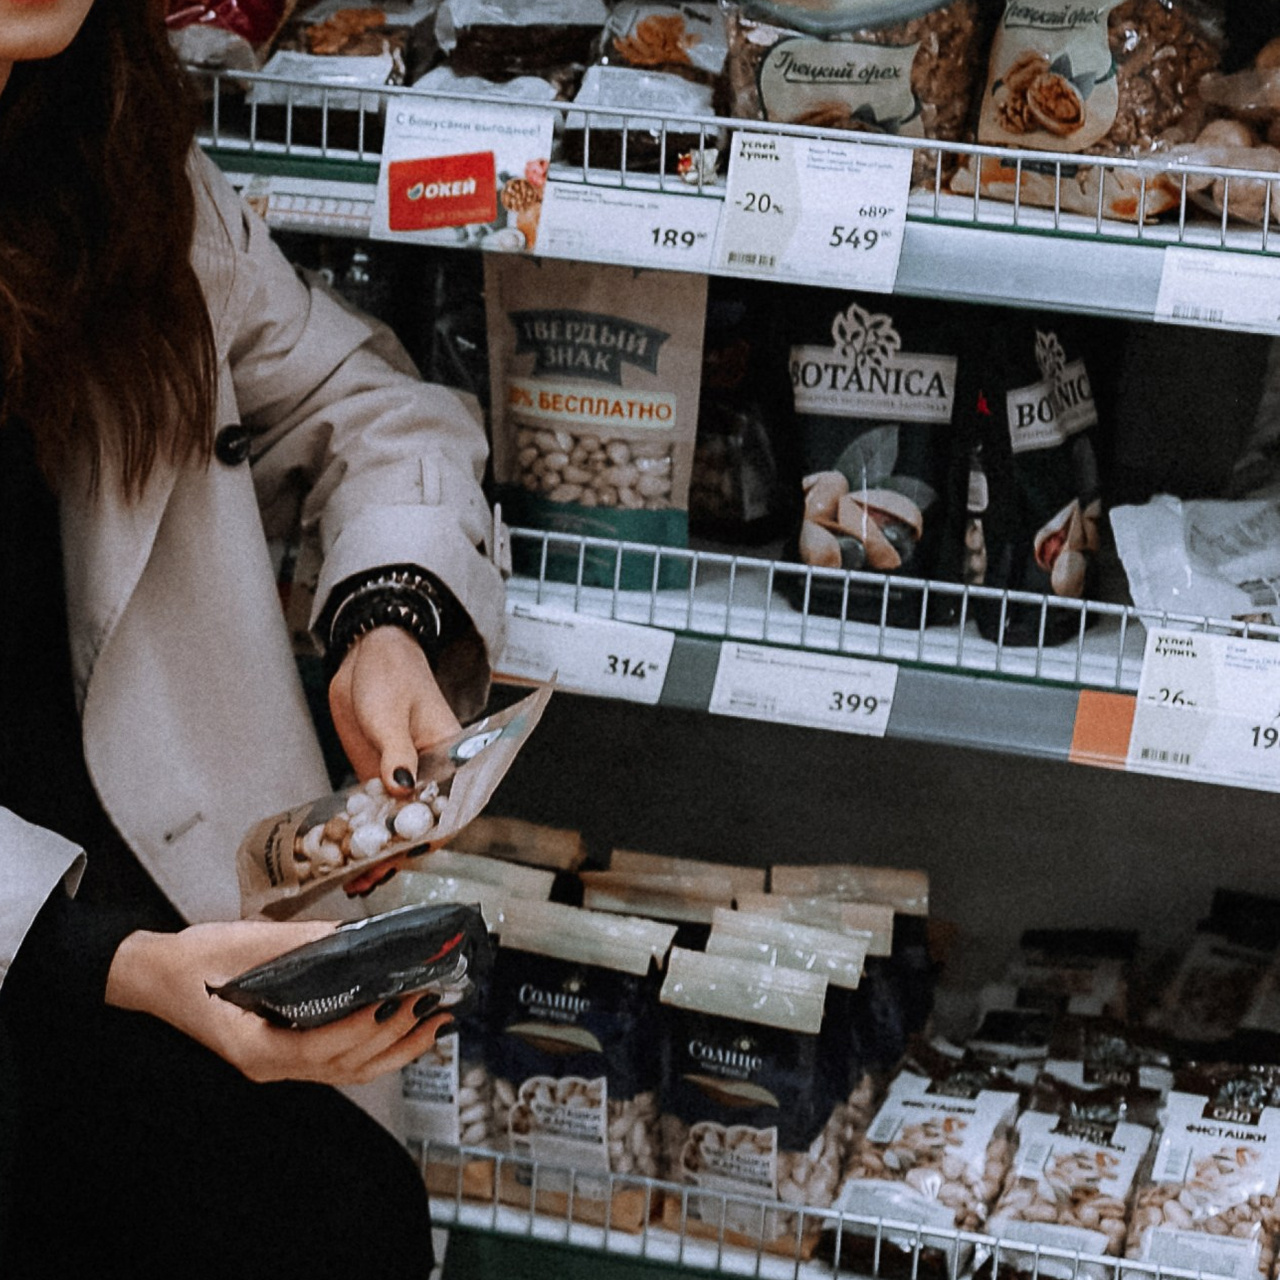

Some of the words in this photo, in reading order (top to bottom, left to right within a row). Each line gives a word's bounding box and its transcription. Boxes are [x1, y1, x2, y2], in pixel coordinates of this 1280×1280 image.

[774, 50, 854, 80] Грецкий
[858, 61, 901, 85] орех
[739, 150, 781, 162] купить
[741, 139, 777, 150] успей
[734, 192, 784, 215] -20%
[650, 227, 696, 250] 189
[829, 225, 879, 250] 549
[523, 321, 649, 357] ТВЕРДЫЙ
[544, 345, 613, 373] ЗНАК
[792, 359, 947, 400] BOTANICA
[537, 389, 673, 422] БЕСПЛАТНО
[1155, 647, 1198, 658] купить
[1157, 635, 1194, 647] успей
[606, 654, 648, 680] 314
[829, 691, 879, 716] 399
